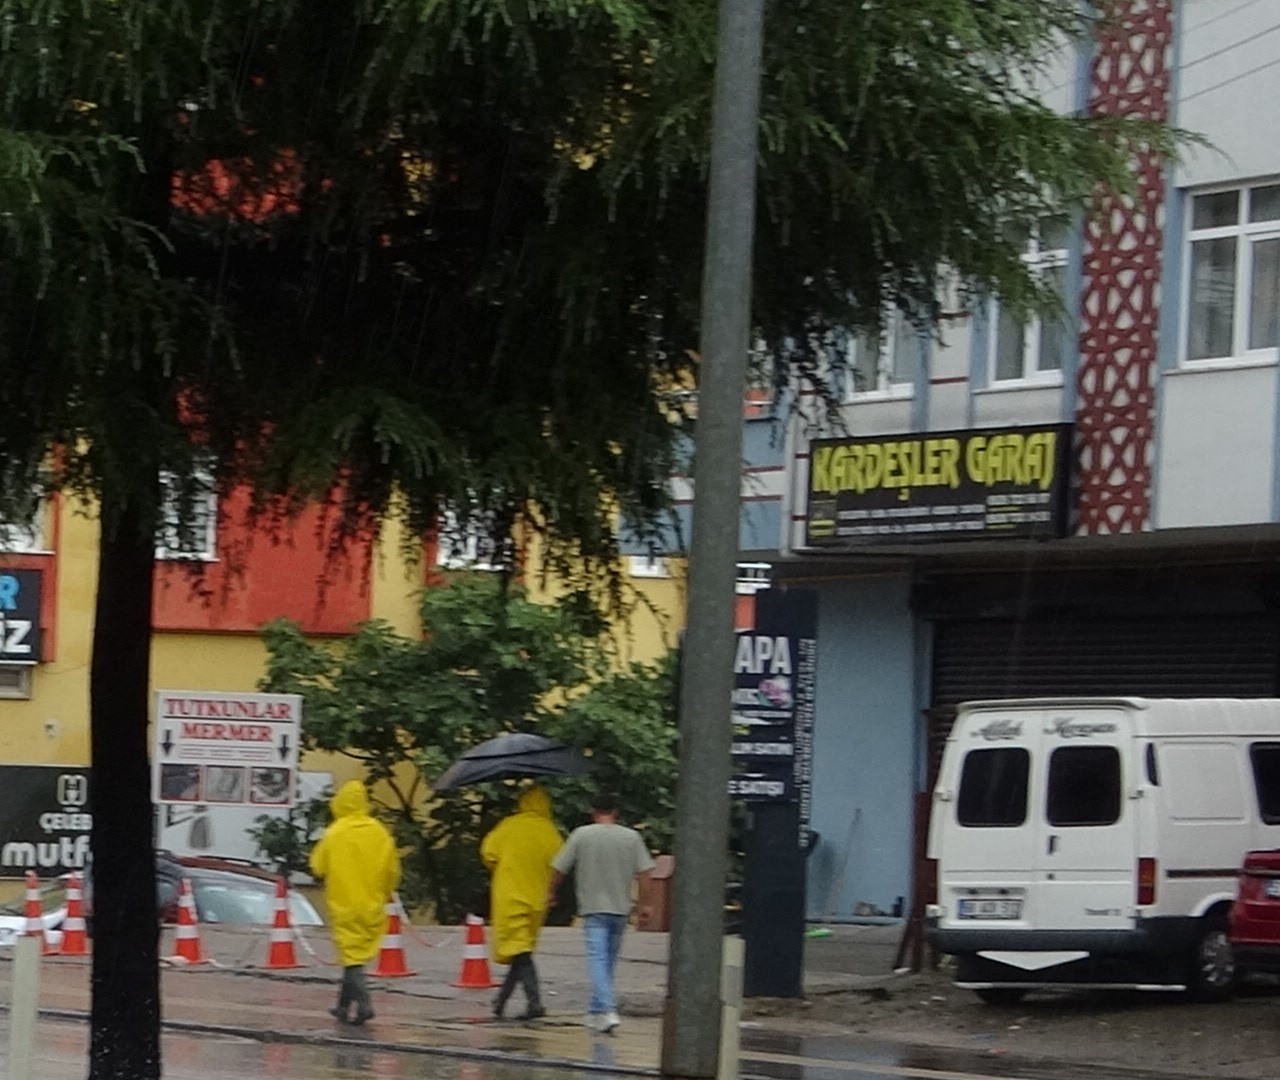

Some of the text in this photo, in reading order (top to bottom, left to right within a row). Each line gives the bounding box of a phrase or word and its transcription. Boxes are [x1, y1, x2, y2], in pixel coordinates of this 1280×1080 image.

[812, 431, 1058, 502] KARDEŞLER GARAJ
[165, 699, 292, 720] TUTKUNLAR
[180, 722, 274, 743] MERMER
[1, 834, 93, 868] mutf
